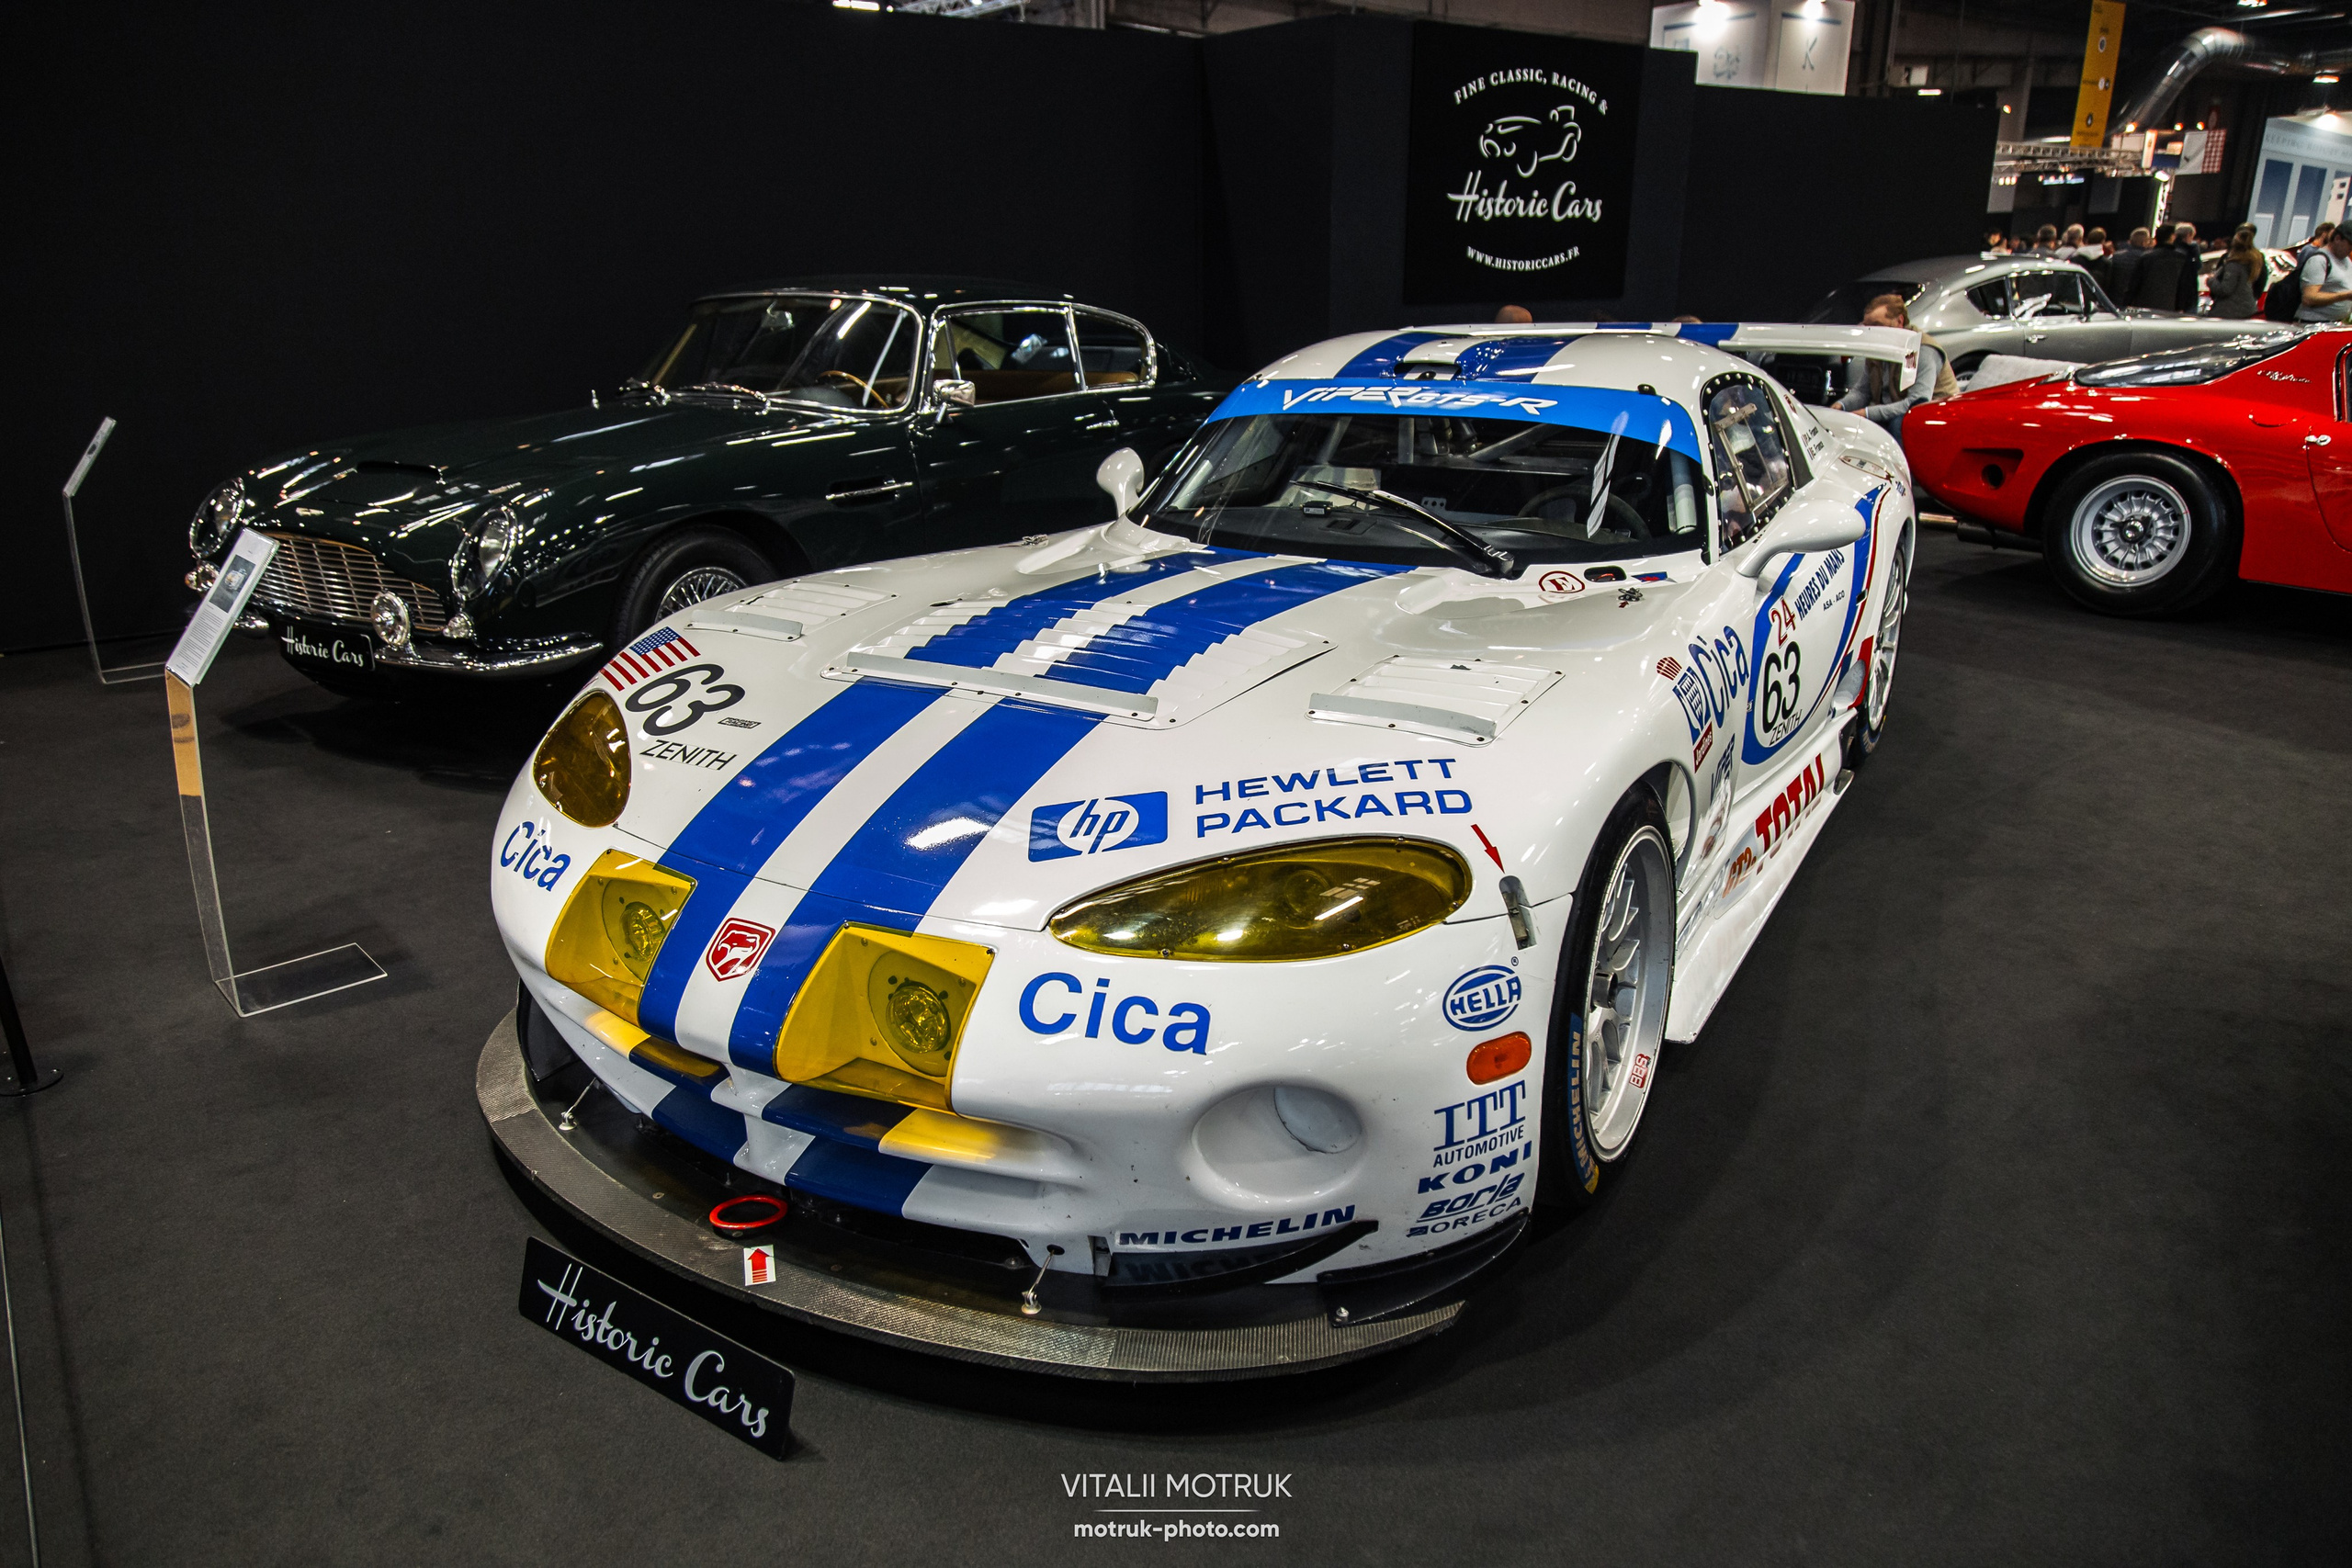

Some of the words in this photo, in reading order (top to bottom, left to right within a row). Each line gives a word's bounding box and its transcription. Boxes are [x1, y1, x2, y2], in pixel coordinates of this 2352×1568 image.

[1453, 77, 1486, 105] FINE
[1489, 68, 1547, 86] CLASSIC,
[1552, 72, 1597, 105] RACING
[1599, 98, 1608, 116] &
[1447, 170, 1549, 222] Historic
[1551, 181, 1602, 222] Cars
[1466, 245, 1580, 271] WWW.HISTORICCARS.FR
[1407, 392, 1558, 416] GTS-R
[1771, 598, 1796, 649] 24
[1794, 577, 1821, 621] HEURES
[1815, 565, 1829, 591] DU
[1824, 549, 1845, 579] MANS
[1823, 599, 1833, 611] ASA
[281, 626, 330, 658] Historic
[333, 640, 364, 667] Cars
[625, 664, 745, 736] 63
[1689, 626, 1749, 728] Cica
[1762, 641, 1801, 733] 63
[1770, 709, 1802, 746] ZENITH
[639, 739, 737, 770] ZENITH
[1194, 759, 1456, 805] HEWLETT
[1069, 798, 1128, 854] hp
[1196, 789, 1473, 838] PACKARD
[501, 821, 571, 891] Cica
[1019, 972, 1211, 1055] Cica
[1450, 976, 1521, 1016] HELLA
[1630, 1055, 1648, 1088] BBS
[1433, 1079, 1526, 1151] ITT
[1571, 1031, 1590, 1168] MICHELIN
[1418, 1140, 1532, 1194] KONI
[1433, 1124, 1524, 1168] AUTOMOTIVE
[1119, 1204, 1355, 1246] MICHELIN
[1430, 1196, 1521, 1234] ORECA
[537, 1263, 673, 1378] Historic
[684, 1350, 769, 1437] Cars
